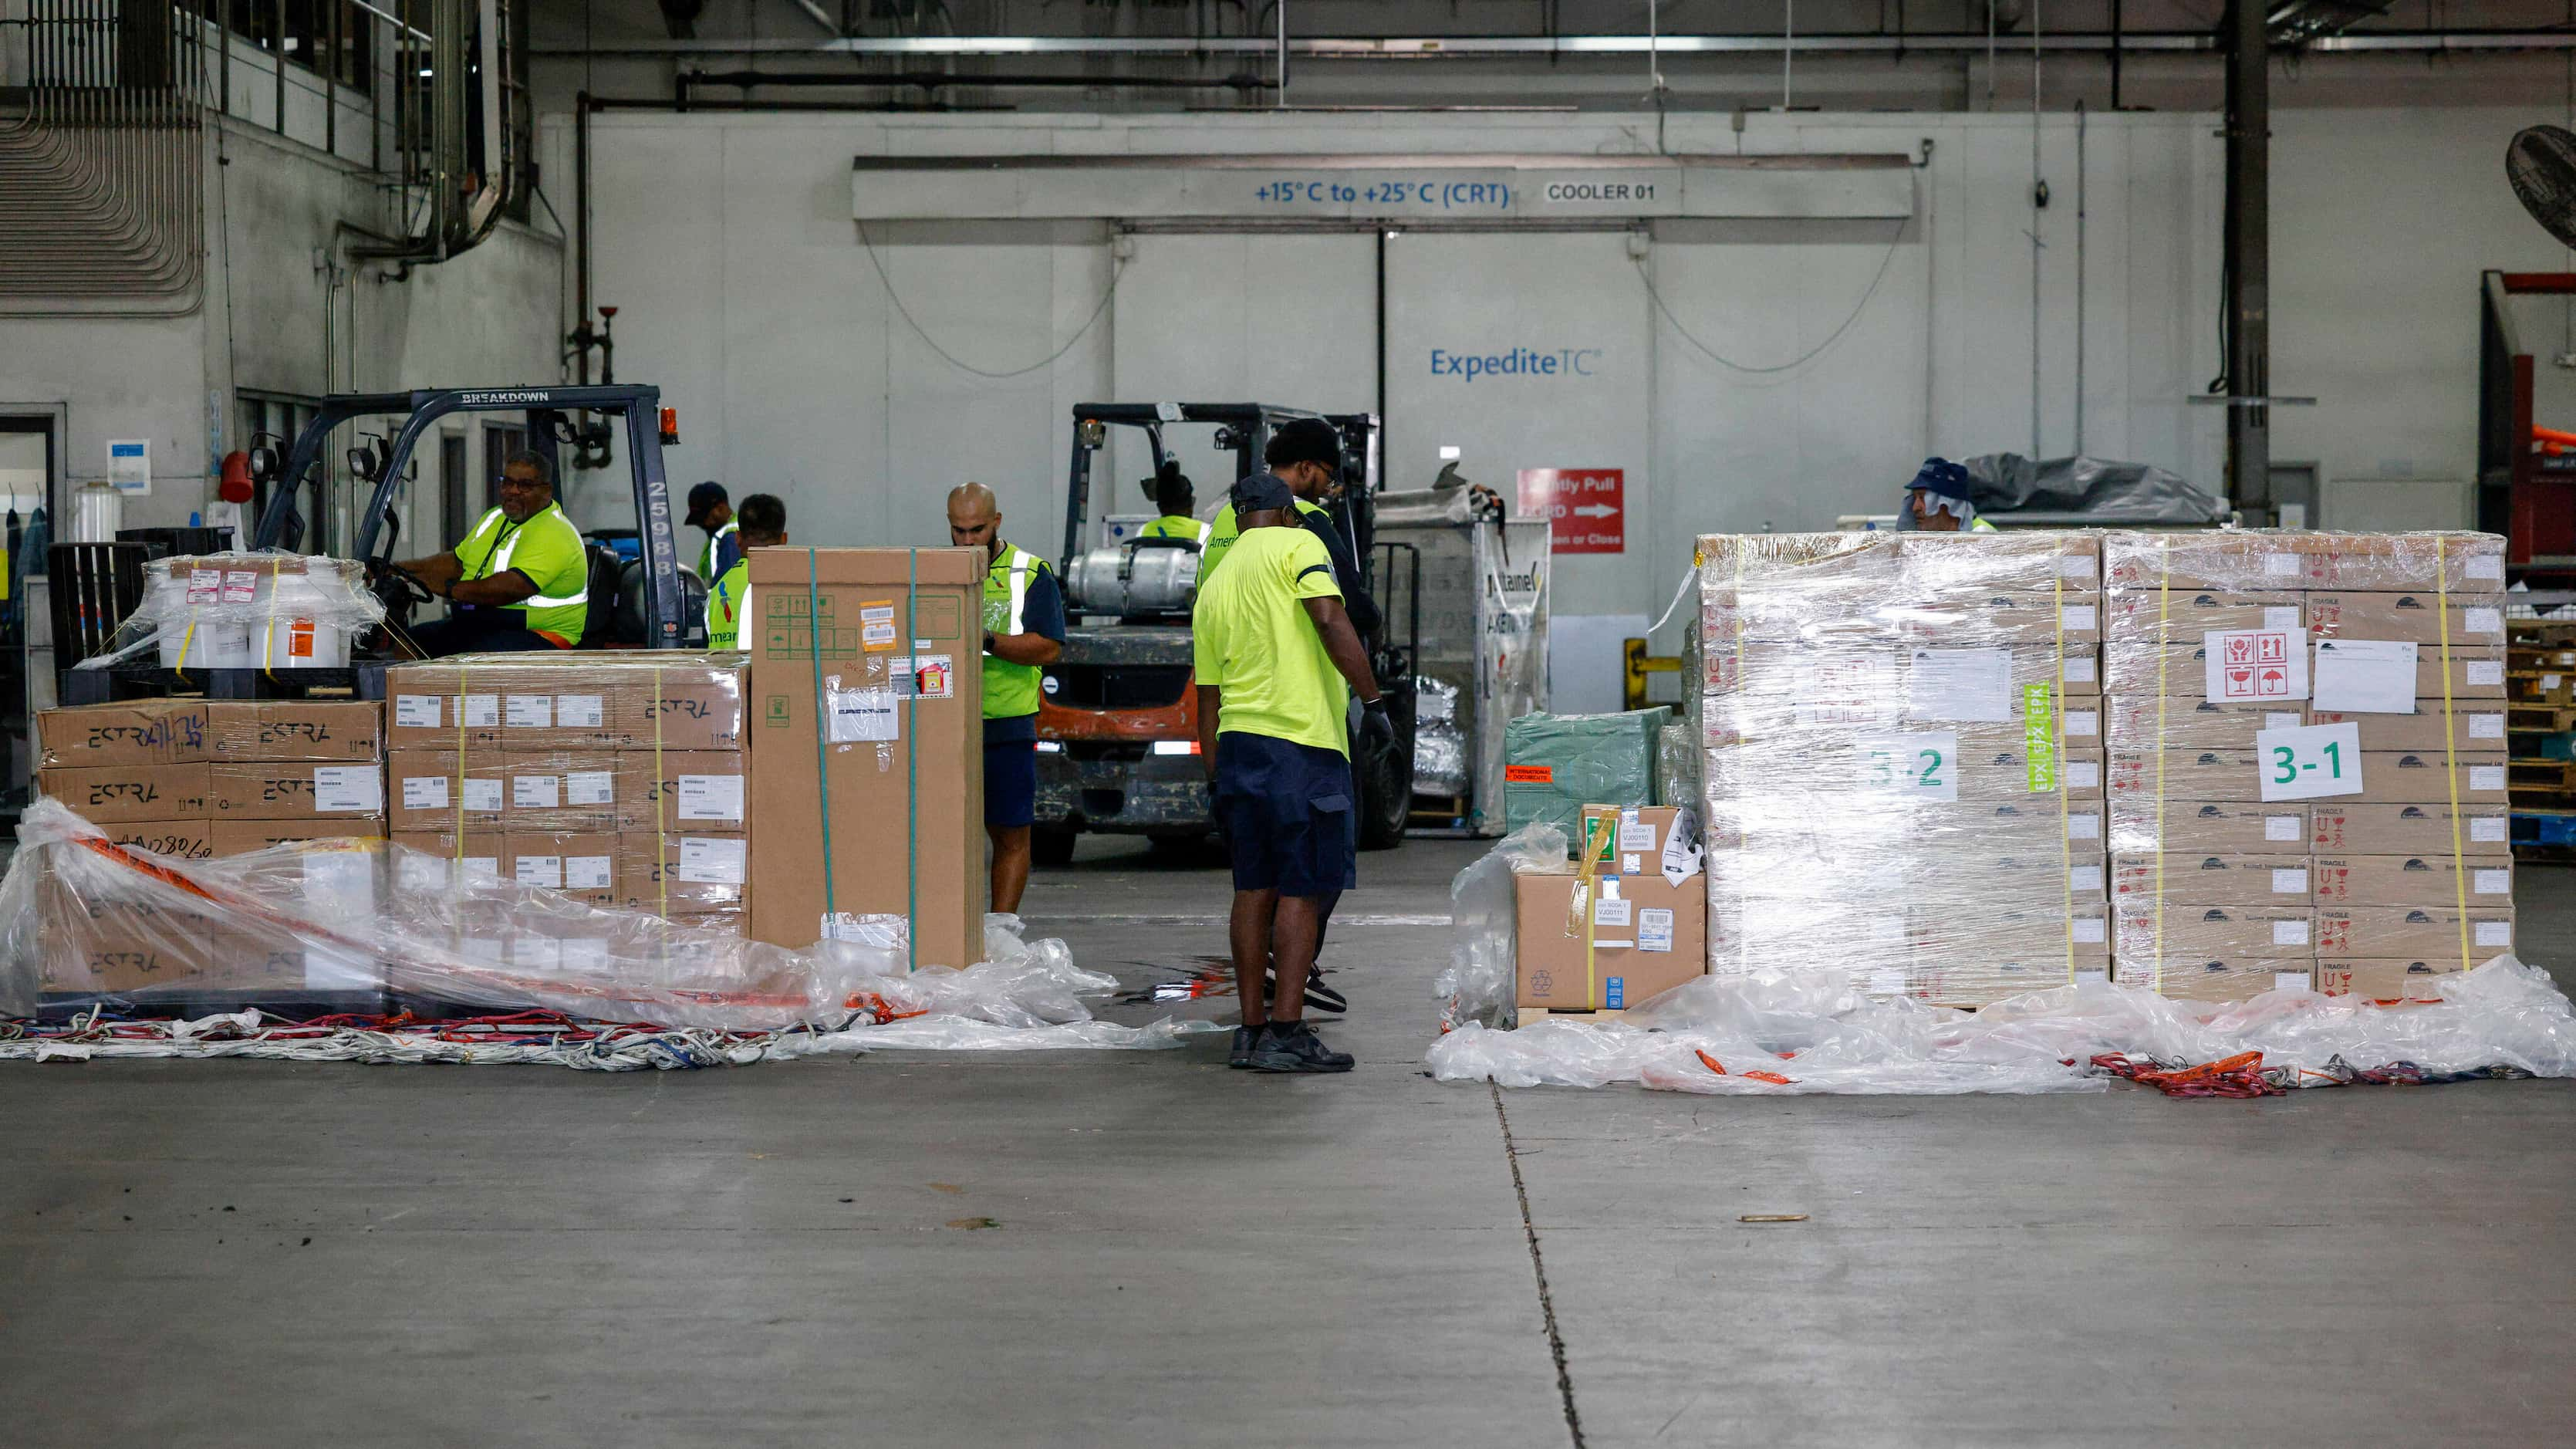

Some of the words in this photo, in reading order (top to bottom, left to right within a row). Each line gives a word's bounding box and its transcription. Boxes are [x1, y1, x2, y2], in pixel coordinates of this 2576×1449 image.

[1331, 182, 1356, 202] to
[1443, 182, 1510, 208] (CRT)
[1548, 183, 1629, 201] COOLER
[1636, 183, 1654, 201] 01
[462, 391, 549, 404] BREAKDOWN
[1584, 477, 1615, 491] Pull
[1573, 535, 1586, 545] or
[1588, 532, 1621, 545] Close
[2032, 725, 2047, 754] EPX
[1869, 748, 1942, 786] 3-2
[2273, 740, 2341, 784] 3-1
[2034, 764, 2048, 791] EPX
